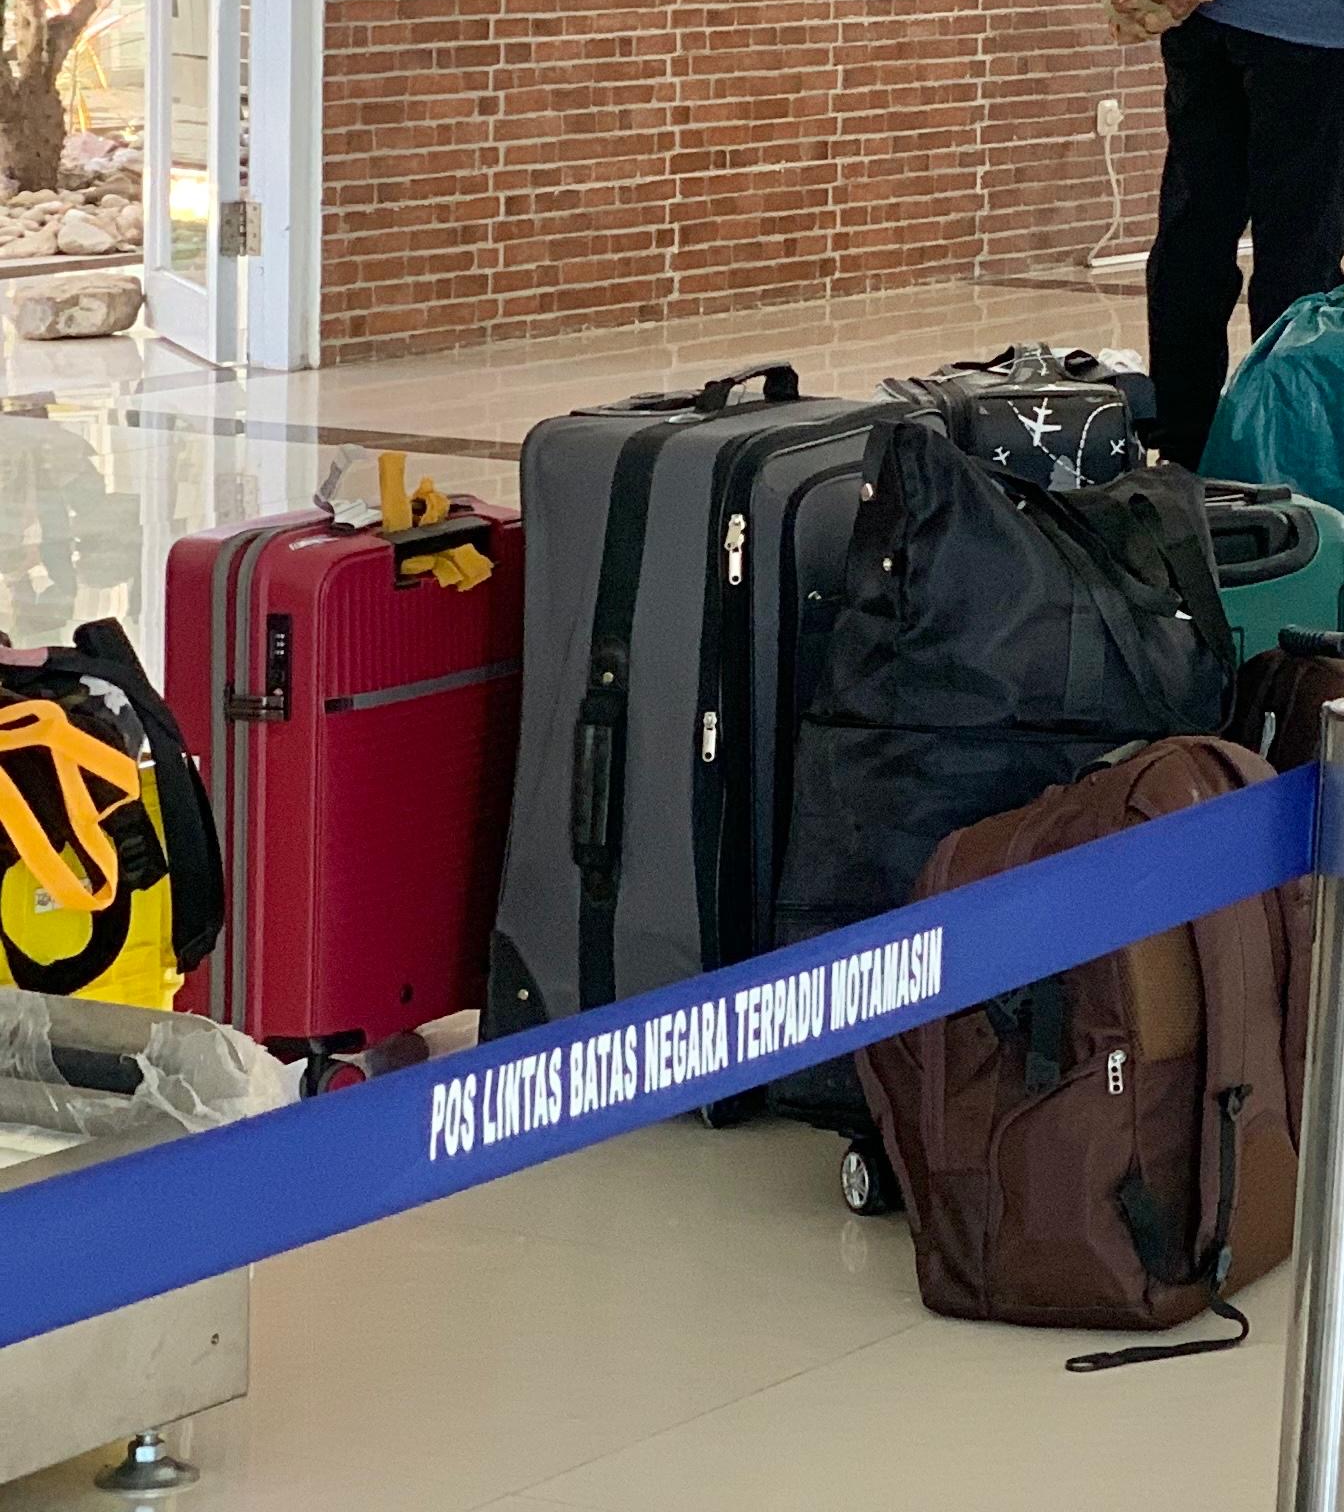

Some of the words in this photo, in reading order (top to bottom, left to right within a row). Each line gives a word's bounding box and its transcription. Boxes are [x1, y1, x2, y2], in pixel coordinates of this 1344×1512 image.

[430, 1074, 476, 1161] POS
[482, 1047, 562, 1145] LINTAS
[569, 1024, 637, 1117] BATAS
[644, 998, 728, 1094] NEGARA
[735, 966, 825, 1062] TERPADU
[830, 927, 943, 1032] MOTAMASIN
